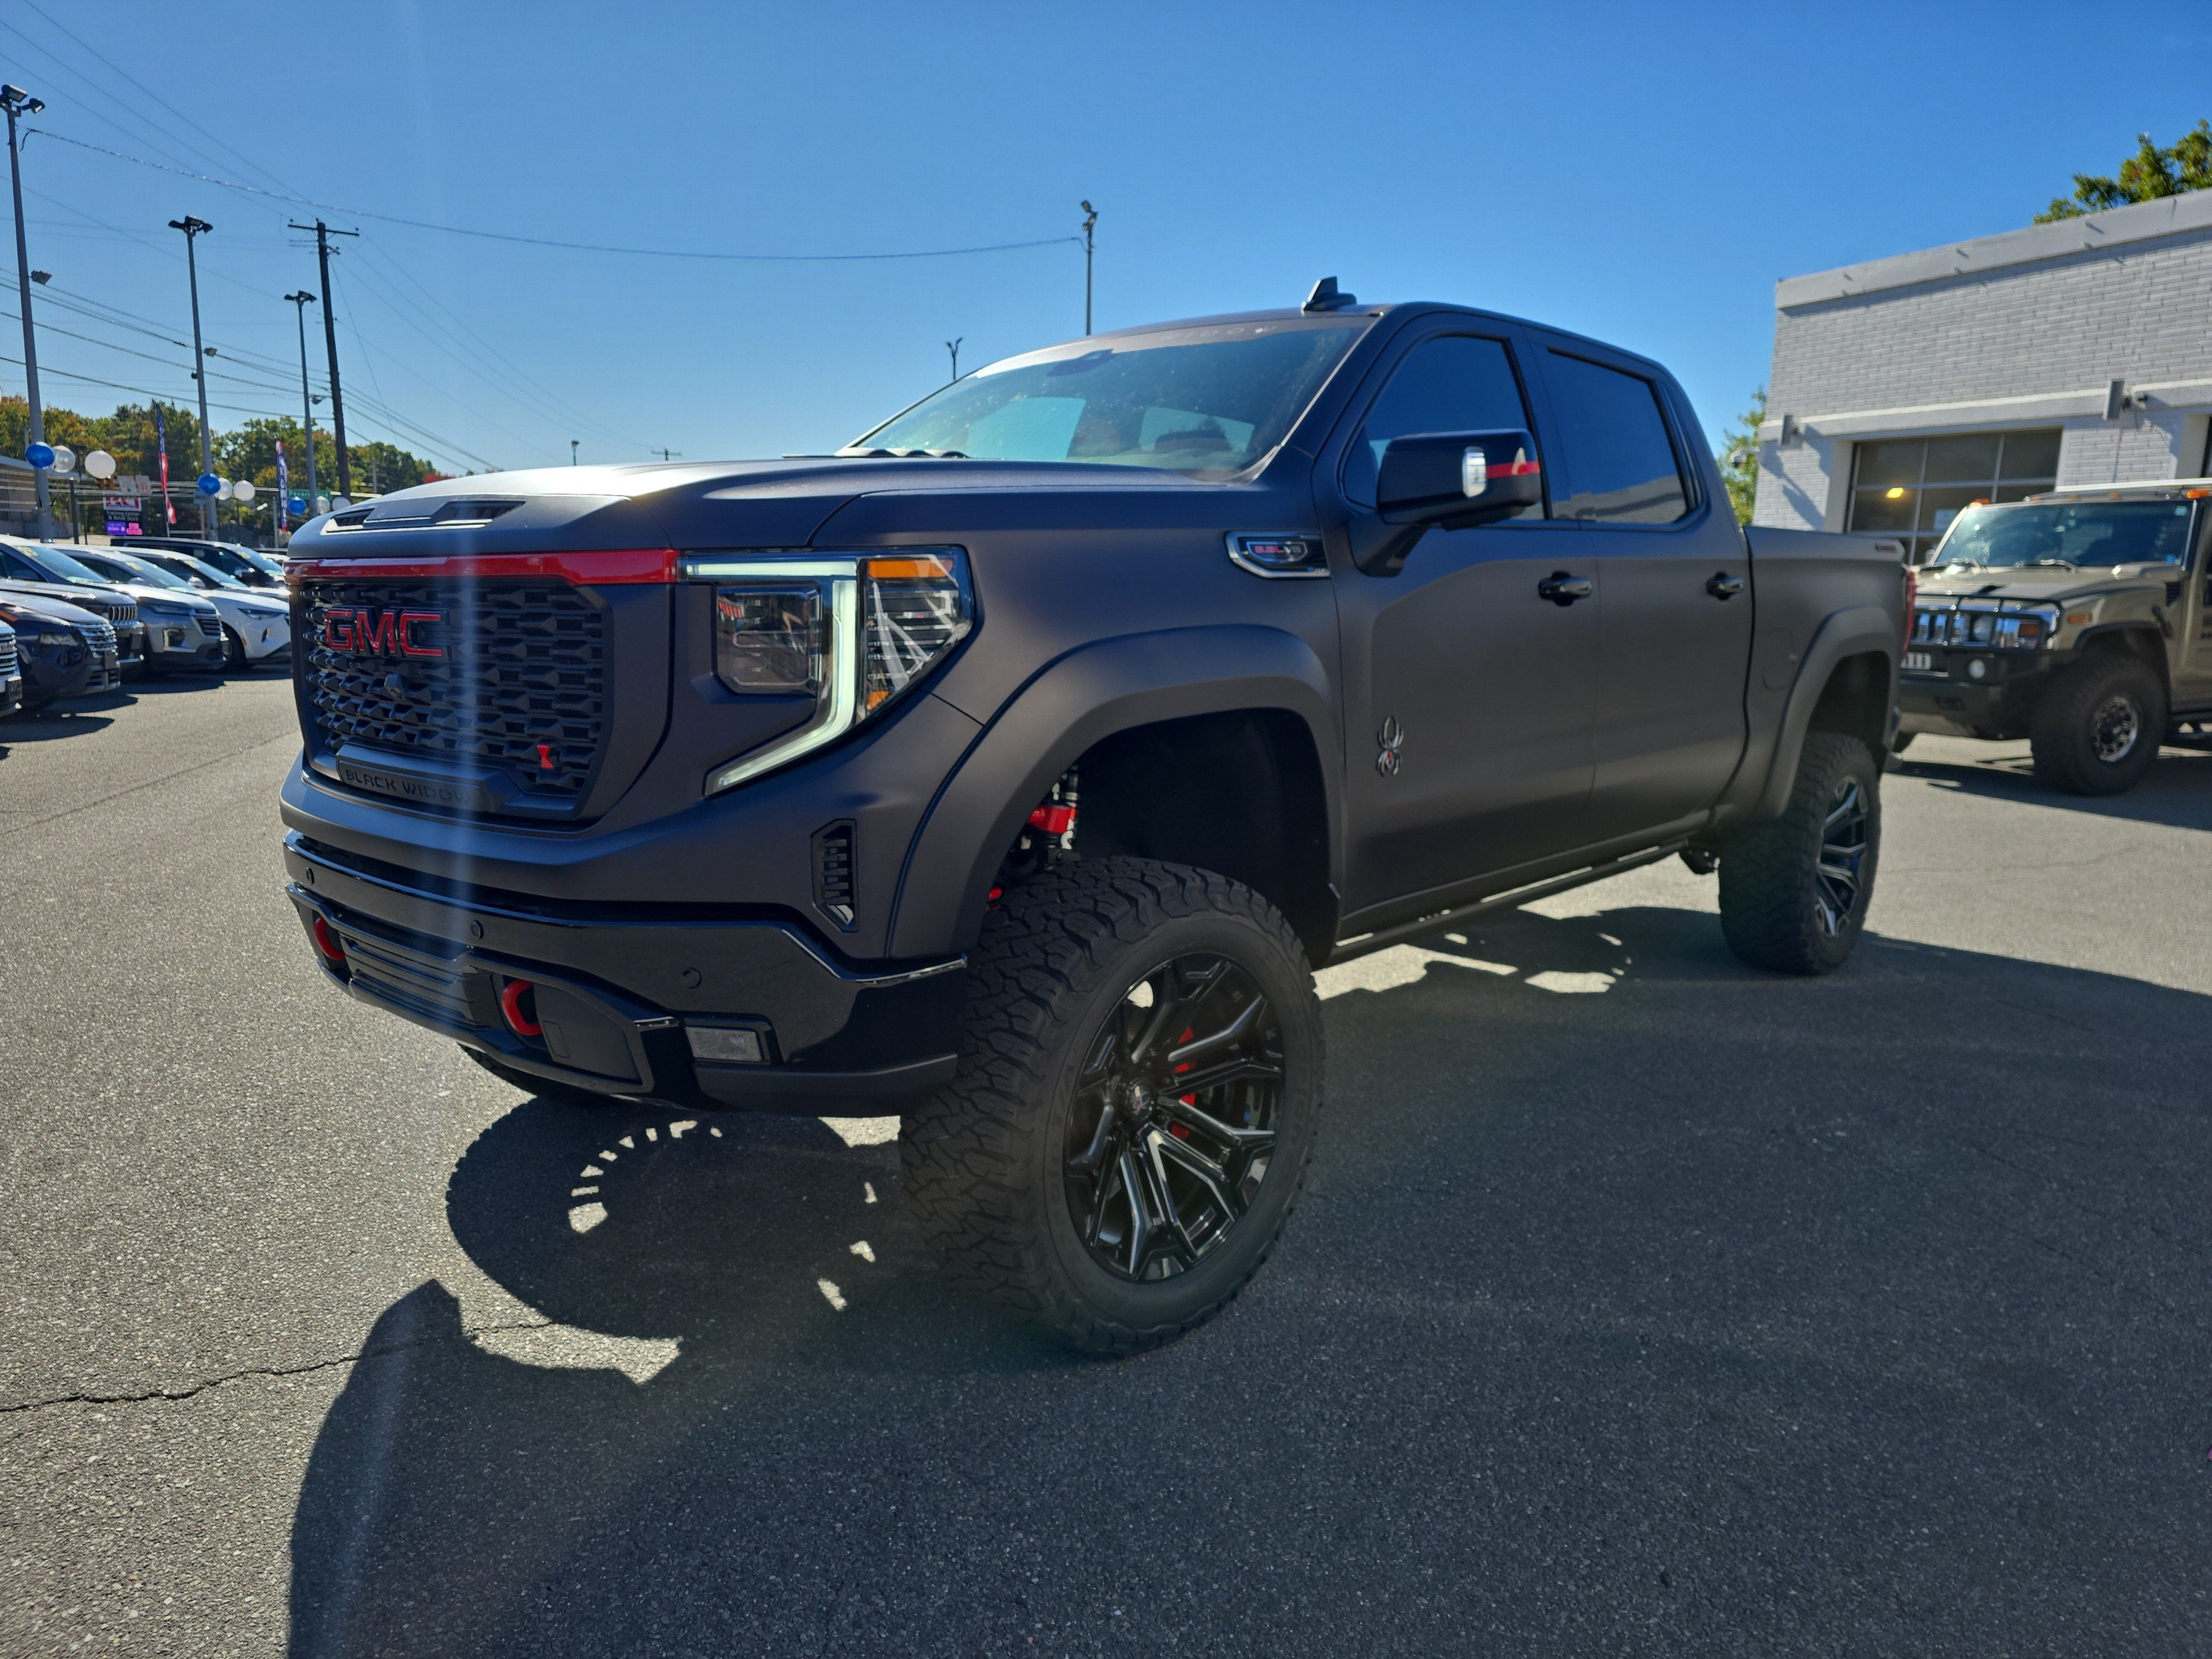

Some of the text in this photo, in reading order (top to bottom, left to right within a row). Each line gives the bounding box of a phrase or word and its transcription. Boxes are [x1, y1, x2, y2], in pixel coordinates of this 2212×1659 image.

[326, 608, 442, 657] GMC
[345, 768, 470, 803] BLACK WIDOW
